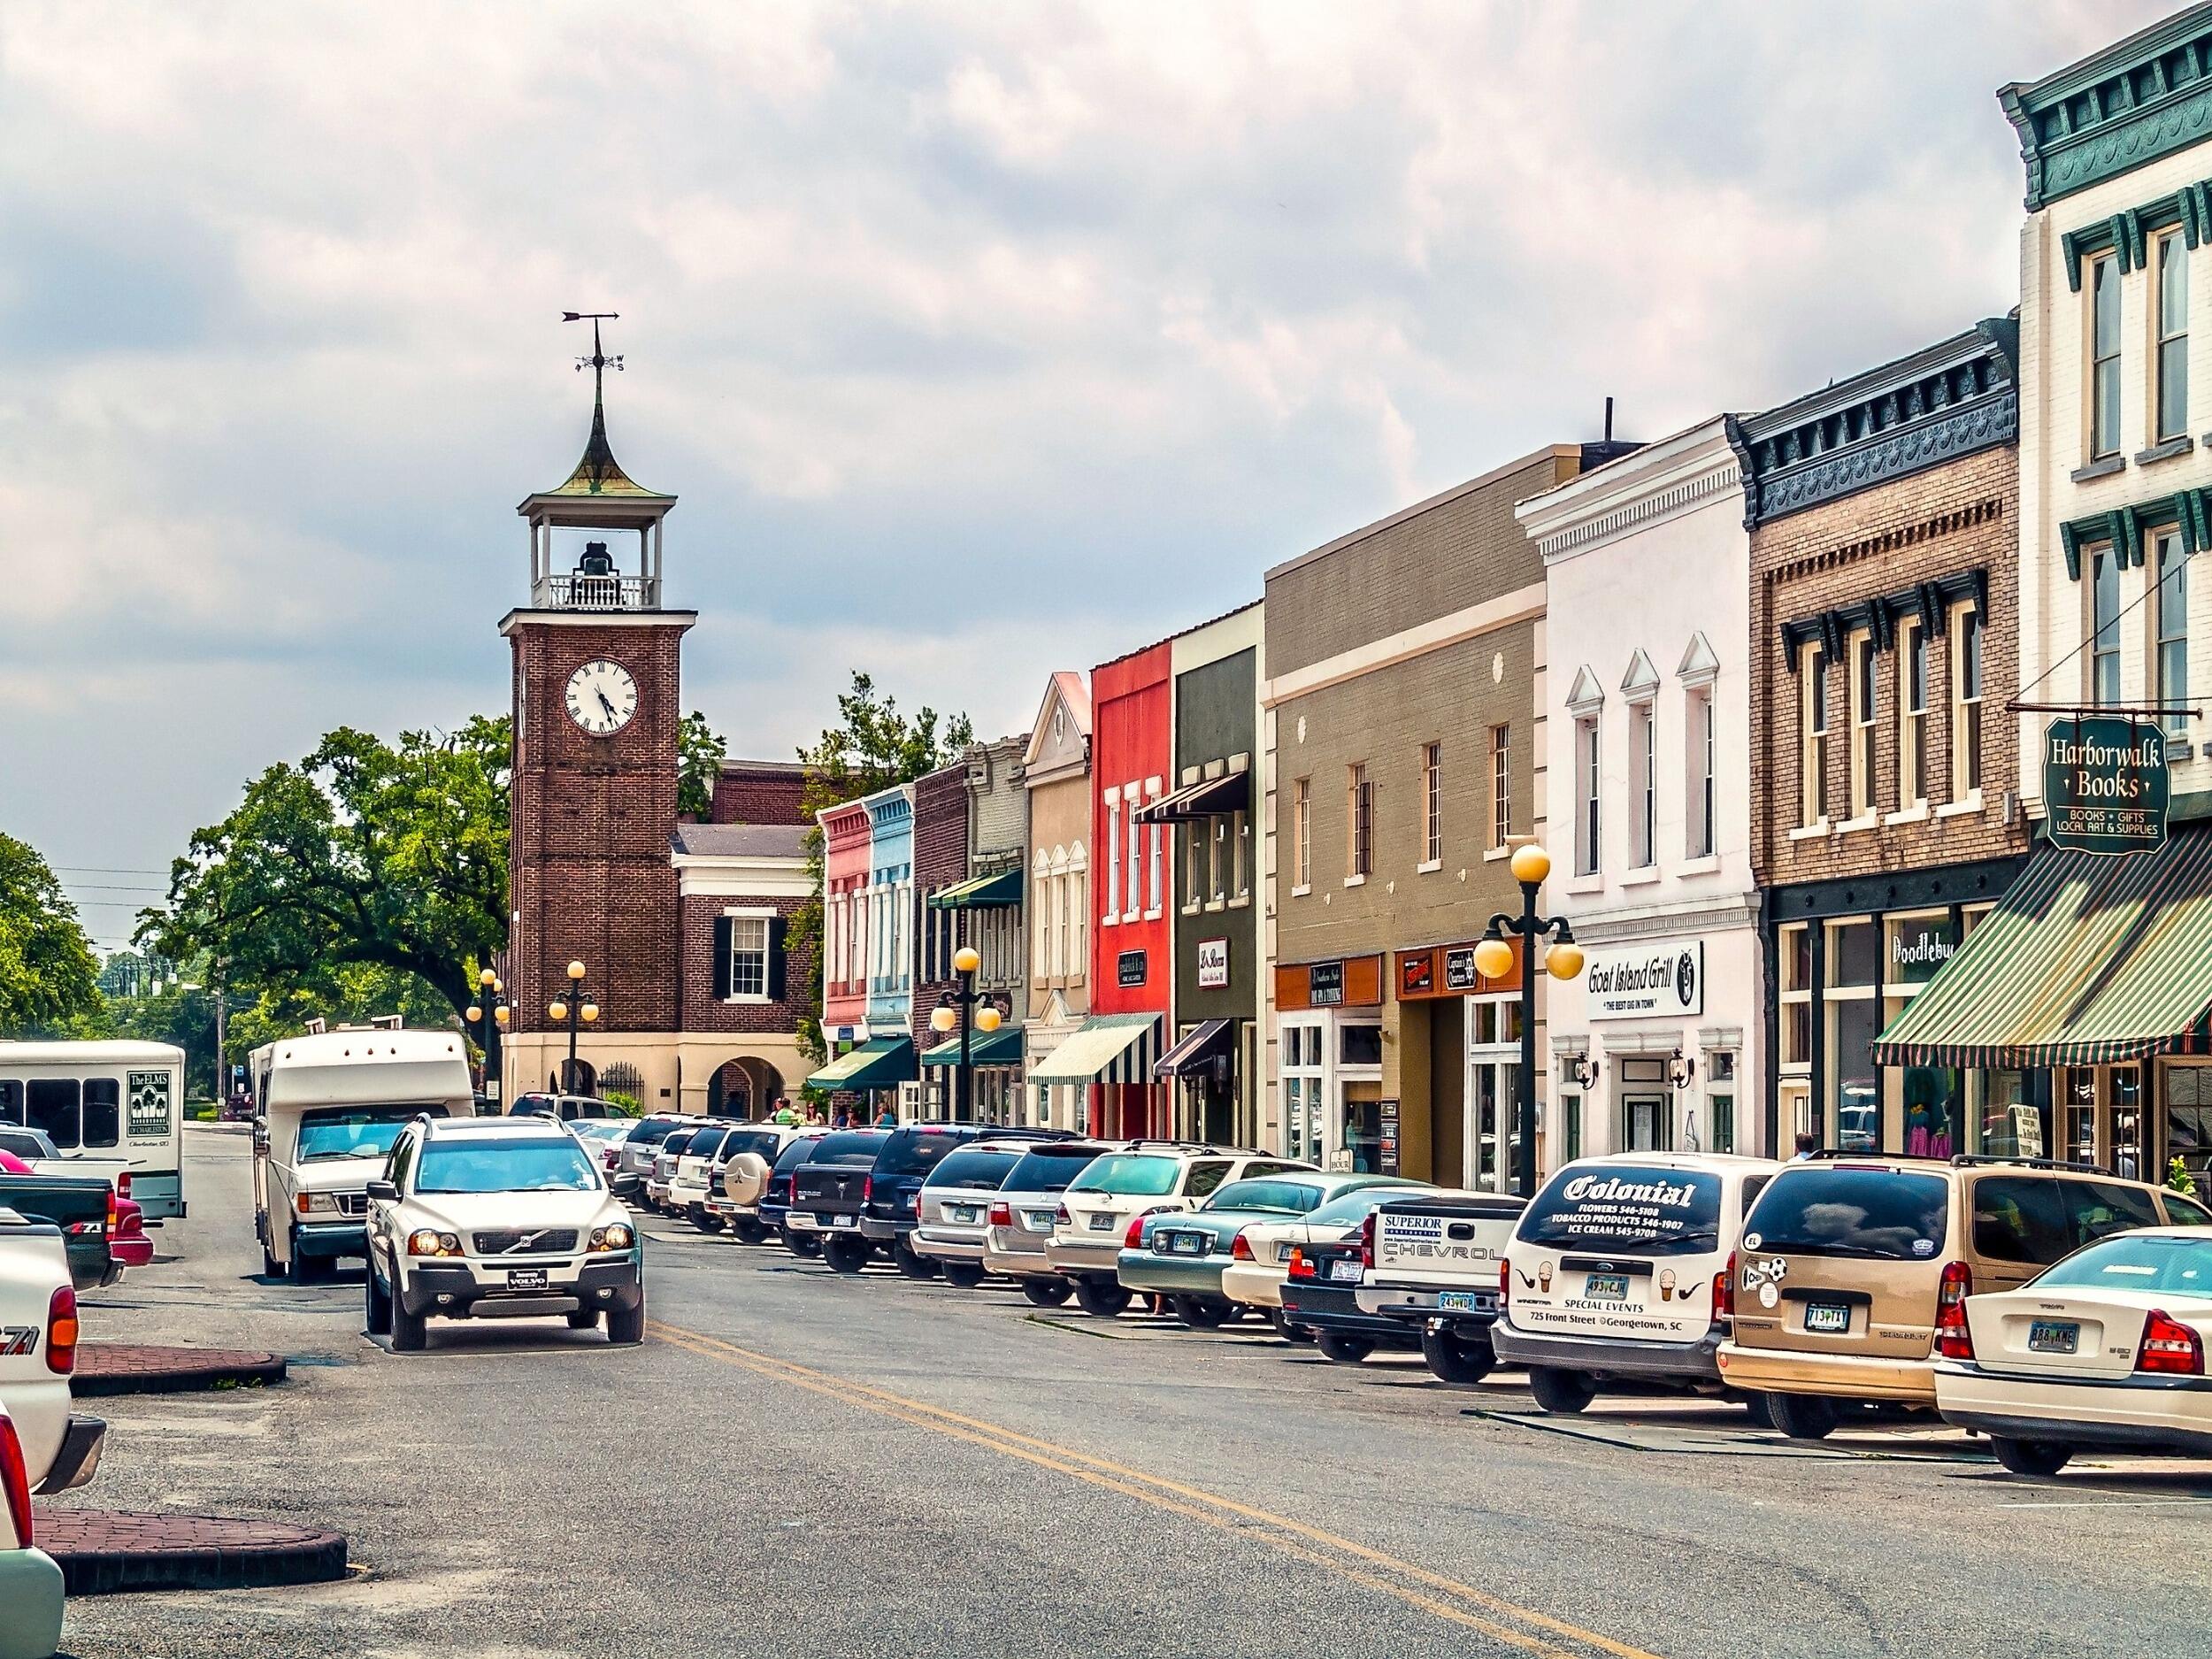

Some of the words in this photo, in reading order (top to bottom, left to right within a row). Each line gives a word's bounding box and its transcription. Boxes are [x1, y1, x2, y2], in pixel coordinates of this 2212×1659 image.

[2052, 736, 2162, 768] Harborwalk
[2076, 768, 2139, 798] Books
[2070, 810, 2105, 822] BOOKS
[2117, 812, 2145, 823] GIFTS
[2056, 821, 2085, 832] LOCAL
[2088, 822, 2105, 833] ART
[2107, 823, 2115, 833] &
[2116, 823, 2158, 834] SUPPLIES
[1589, 963, 1614, 994] Goat
[1615, 959, 1649, 991] Island
[1648, 956, 1673, 989] Grill
[1616, 1000, 1626, 1010] BEST
[1635, 999, 1640, 1009] IN
[131, 1075, 144, 1085] The
[144, 1074, 167, 1085] ELMS
[1563, 1175, 1696, 1208] Colonial
[1578, 1203, 1618, 1214] FLOWERS
[1618, 1205, 1660, 1217] 546-5108
[71, 1222, 102, 1233] Z71
[1385, 1216, 1441, 1229] SUPERIOR
[1552, 1214, 1591, 1224] TOBACCO
[1593, 1214, 1640, 1225] PRODUCTS
[1641, 1217, 1684, 1231] 546-1907
[1568, 1225, 1583, 1233] ICE
[1583, 1225, 1614, 1235] CREAM
[1615, 1226, 1657, 1238] 545-9708
[1441, 1297, 1455, 1307] 243
[1564, 1300, 1602, 1311] SPECIAL
[1606, 1302, 1644, 1313] EVENTS
[1530, 1312, 1544, 1321] 725
[1546, 1313, 1568, 1323] Front
[1569, 1314, 1596, 1325] Street
[1606, 1317, 1667, 1331] Georgetown,
[1670, 1322, 1682, 1331] SC
[1809, 1310, 1824, 1324] 713
[0, 1326, 40, 1356] 71
[2032, 1328, 2050, 1341] 888
